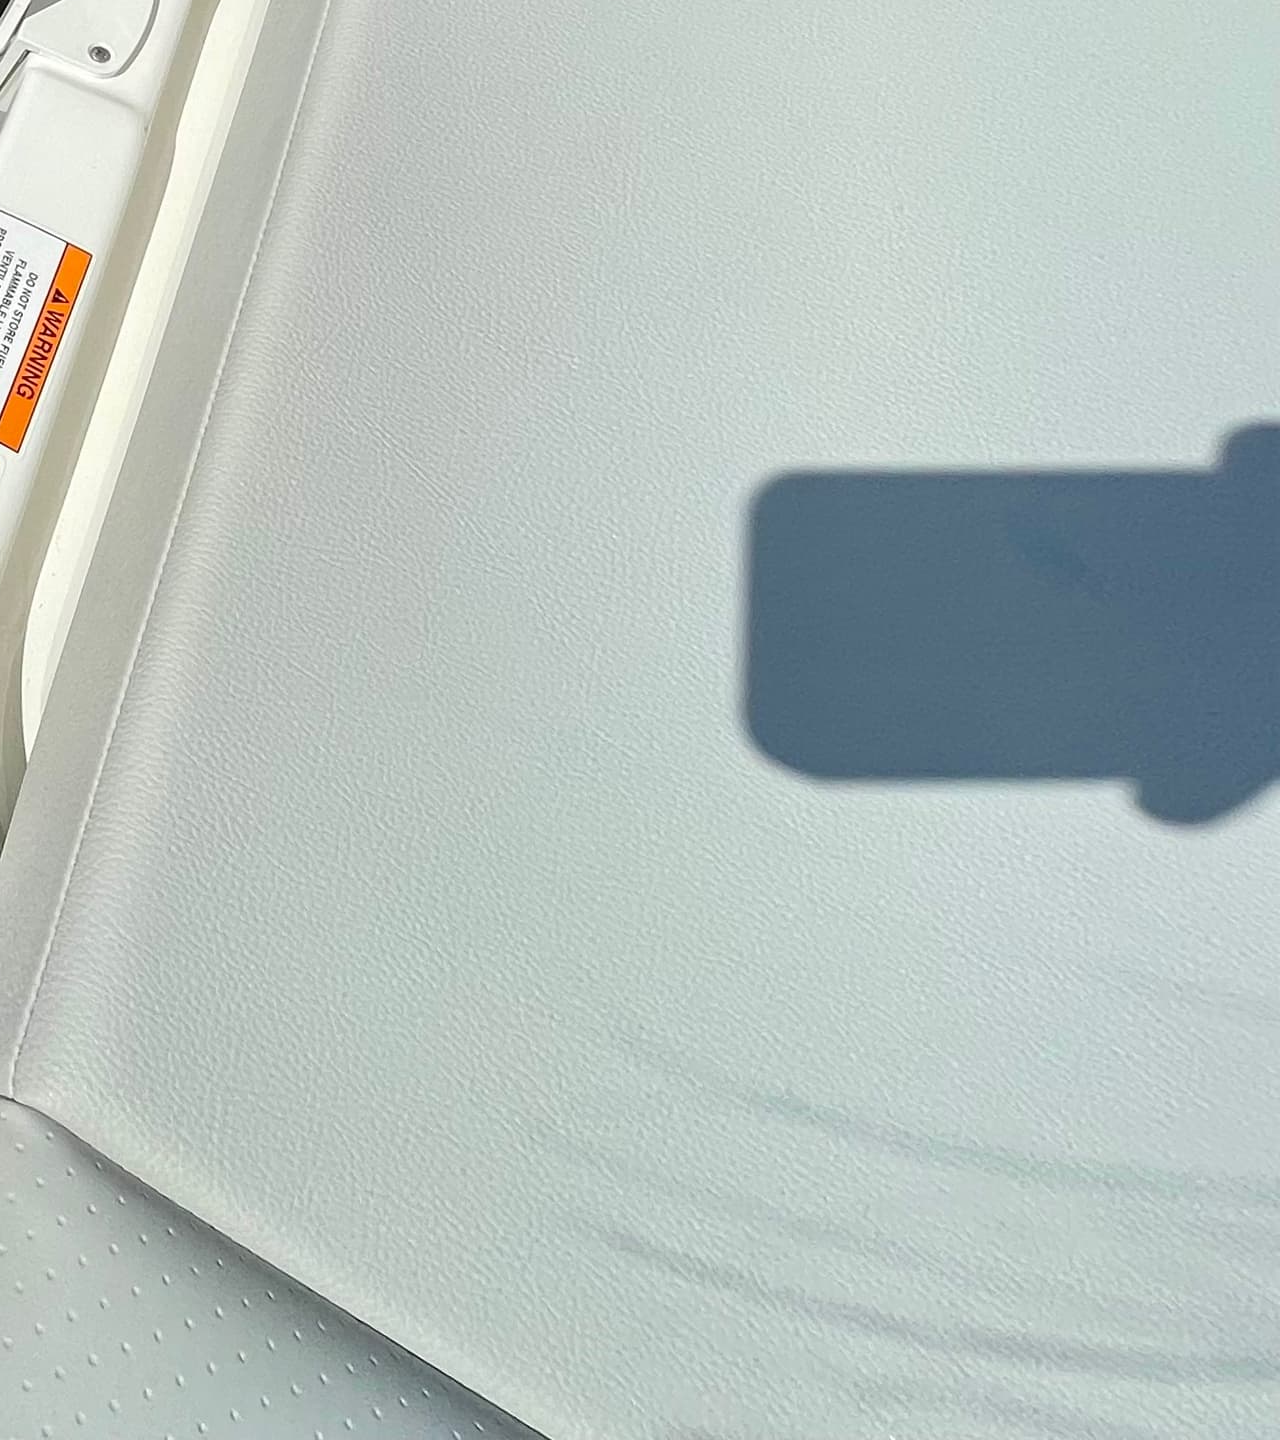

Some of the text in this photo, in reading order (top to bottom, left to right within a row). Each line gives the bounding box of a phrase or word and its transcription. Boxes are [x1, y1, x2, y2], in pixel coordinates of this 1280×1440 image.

[23, 270, 39, 289] DO
[15, 286, 33, 310] NOT
[1, 307, 24, 344] STORE
[14, 305, 65, 402] WARNING
